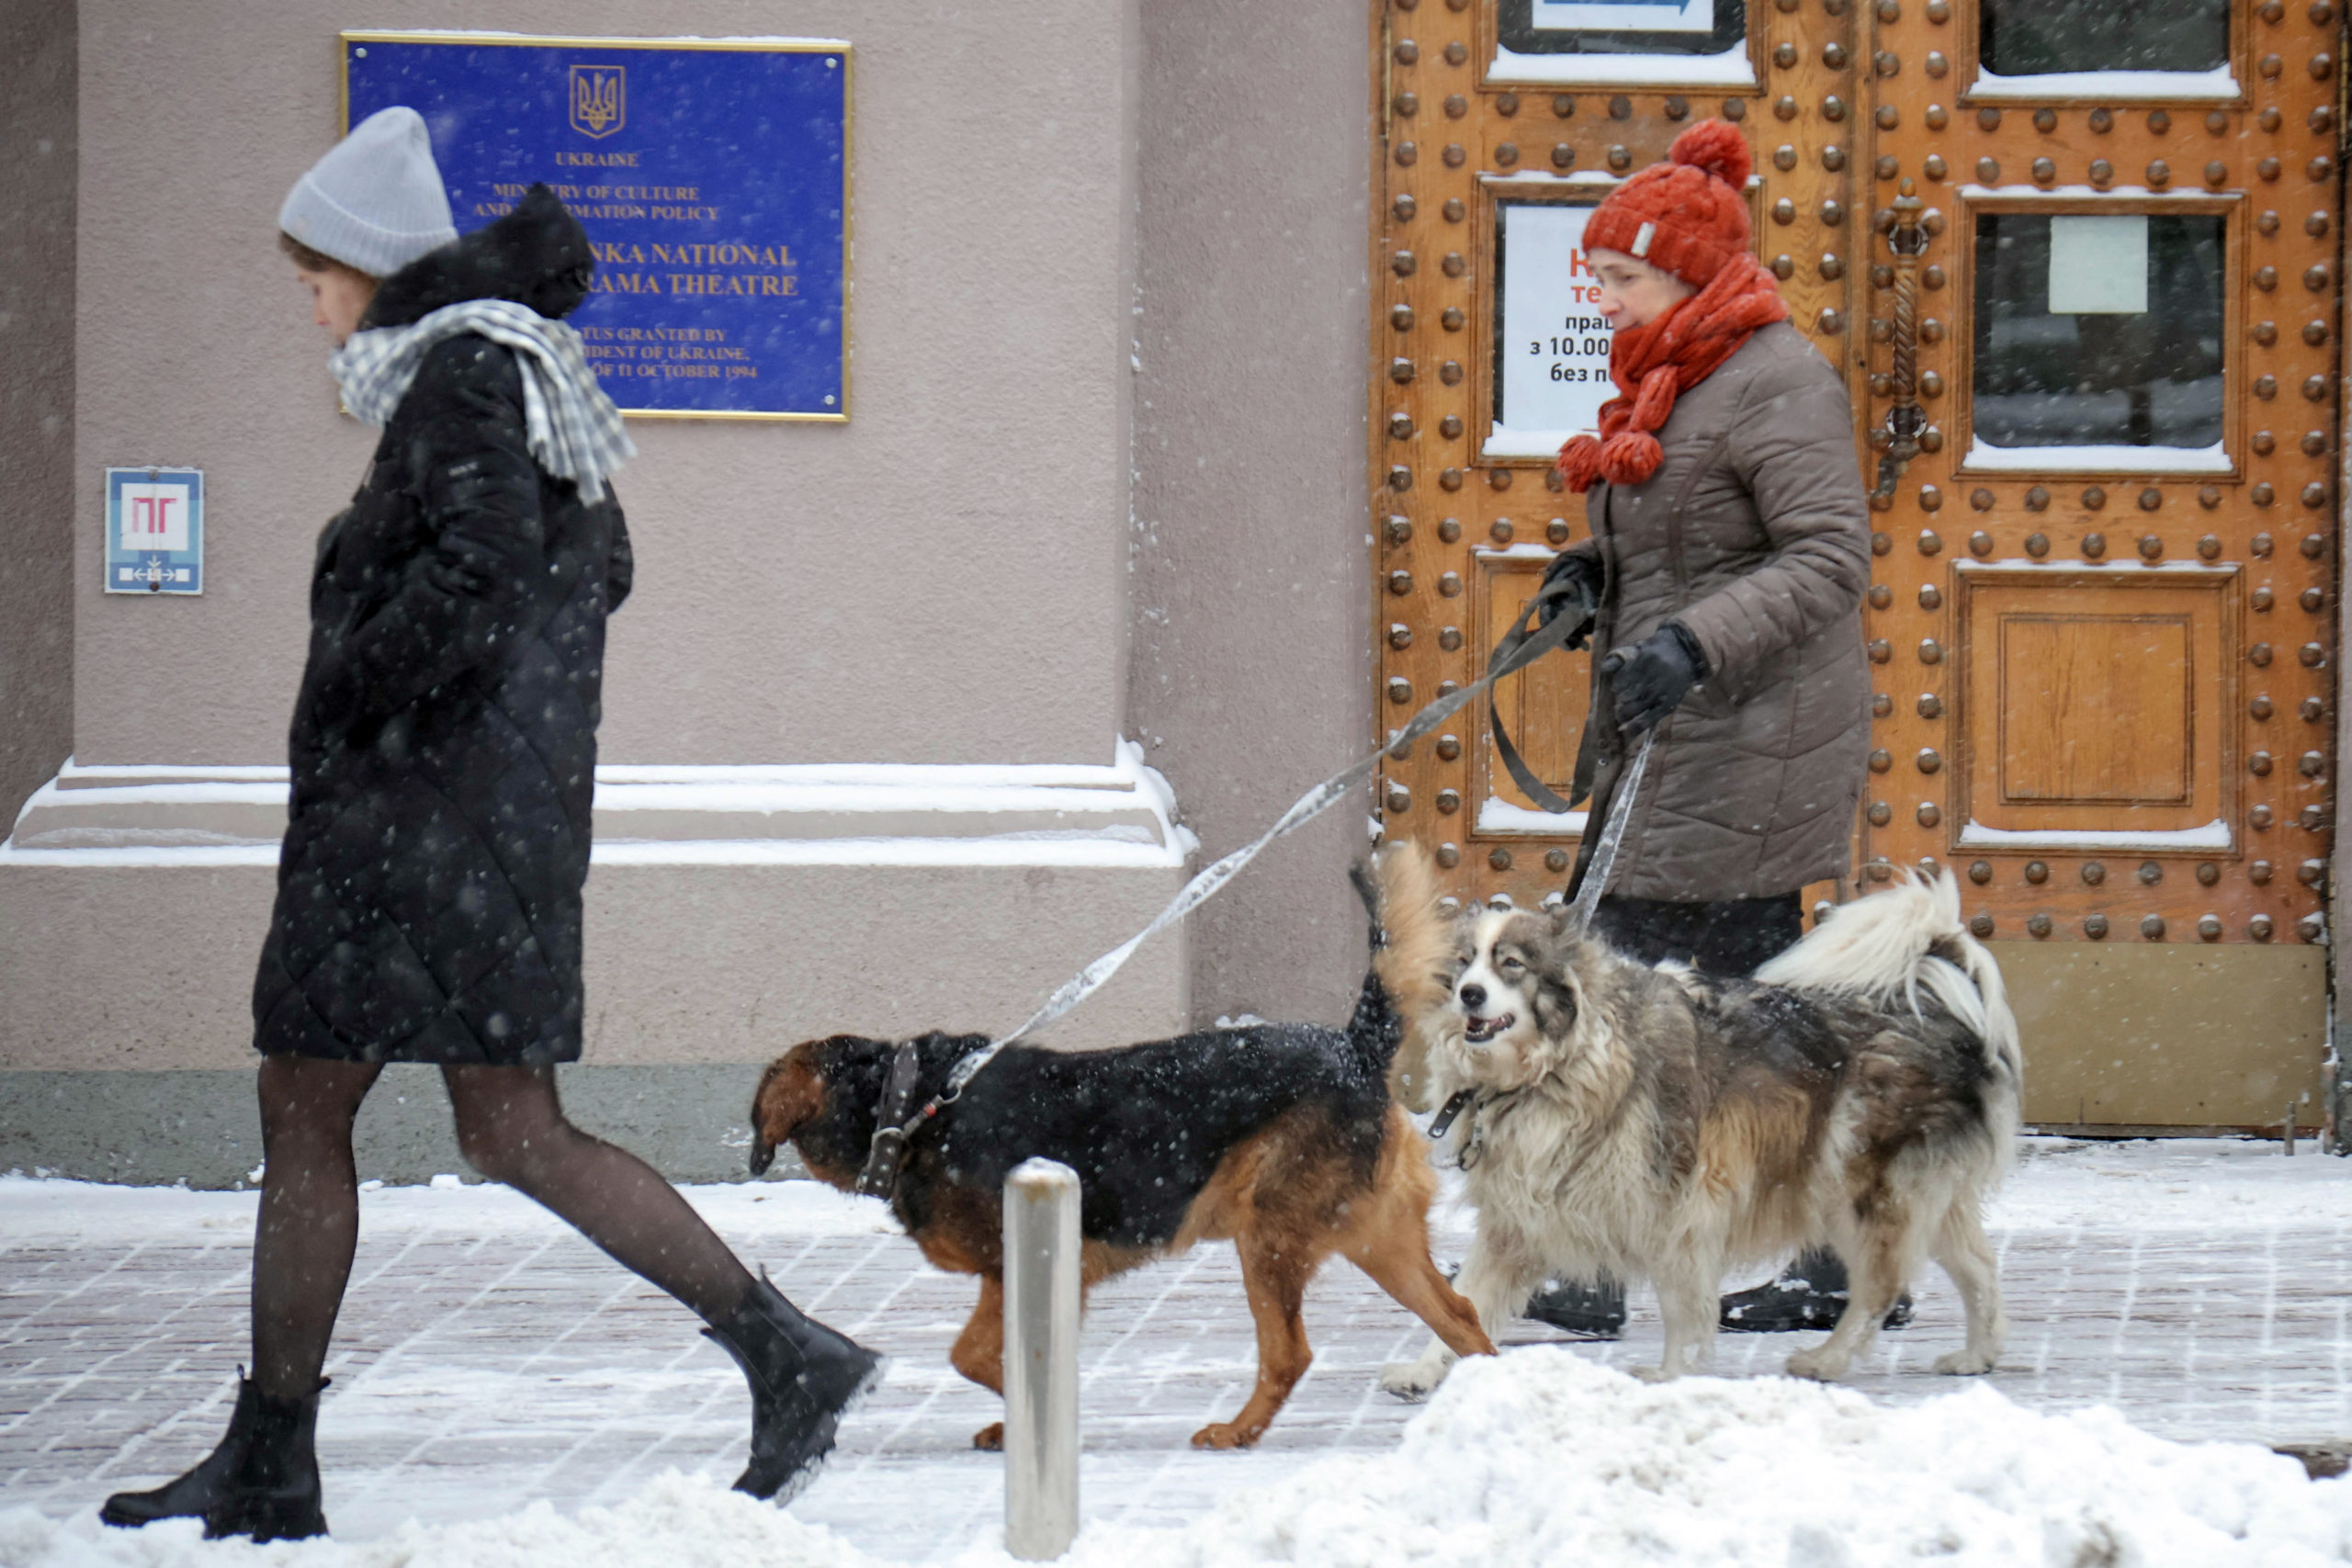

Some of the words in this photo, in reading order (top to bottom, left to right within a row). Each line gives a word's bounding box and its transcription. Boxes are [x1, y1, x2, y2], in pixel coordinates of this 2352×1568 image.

[555, 152, 639, 167] UKRAINE
[492, 183, 581, 198] MINTRY
[586, 185, 609, 199] OF
[615, 186, 700, 200] CULTURE
[473, 202, 513, 217] AND
[650, 205, 721, 220] POLICY
[651, 243, 797, 265] NATIONAL
[666, 274, 799, 296] THEATRE
[582, 326, 614, 341] TUS
[616, 328, 701, 342] GRANTED
[704, 328, 726, 342] BY
[584, 344, 638, 358] IDENT
[640, 345, 665, 359] OF
[668, 346, 751, 360] UKRAINE,
[1530, 342, 1541, 355] з
[1551, 337, 1610, 356] 10.00
[618, 364, 632, 377] 11
[637, 364, 720, 378] OCTOBER
[725, 366, 758, 378] 1994
[1551, 363, 1588, 382] без
